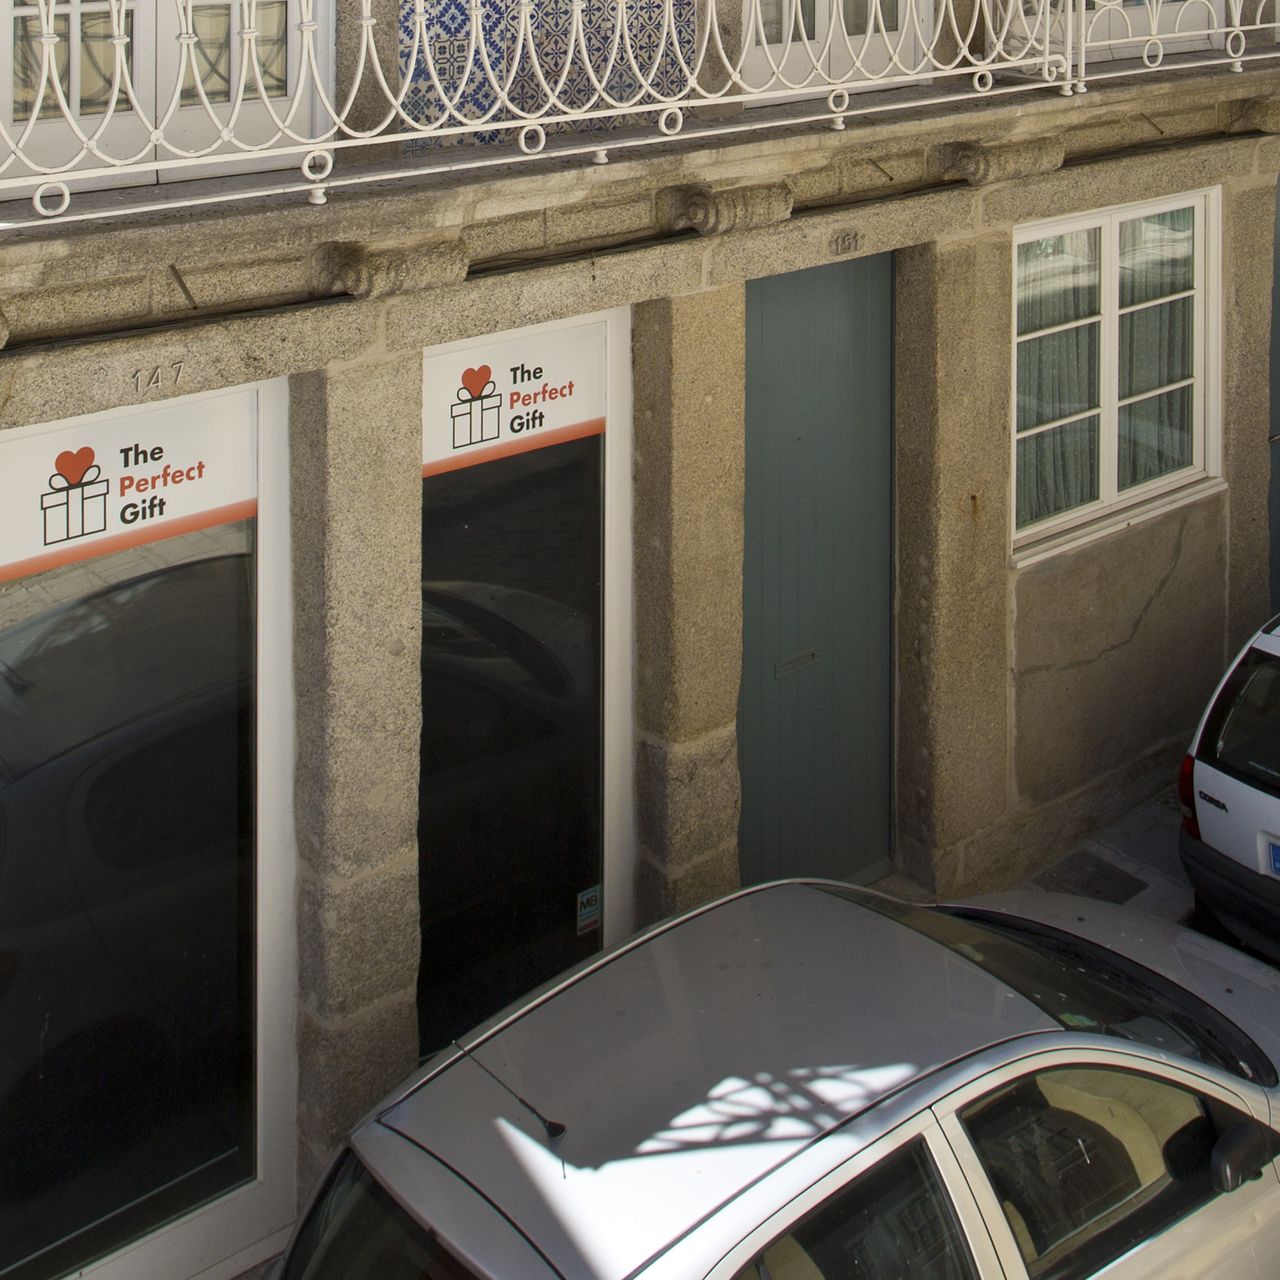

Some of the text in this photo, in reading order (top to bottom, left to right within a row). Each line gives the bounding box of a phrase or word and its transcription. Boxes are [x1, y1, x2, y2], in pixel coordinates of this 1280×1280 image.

[834, 231, 860, 253] 151
[131, 360, 185, 393] 147
[509, 363, 544, 385] The
[509, 380, 575, 409] Perfect
[509, 409, 545, 435] Gift
[119, 443, 164, 468] The
[119, 460, 206, 497] Perfect
[119, 495, 166, 526] Gift
[578, 894, 599, 912] MB
